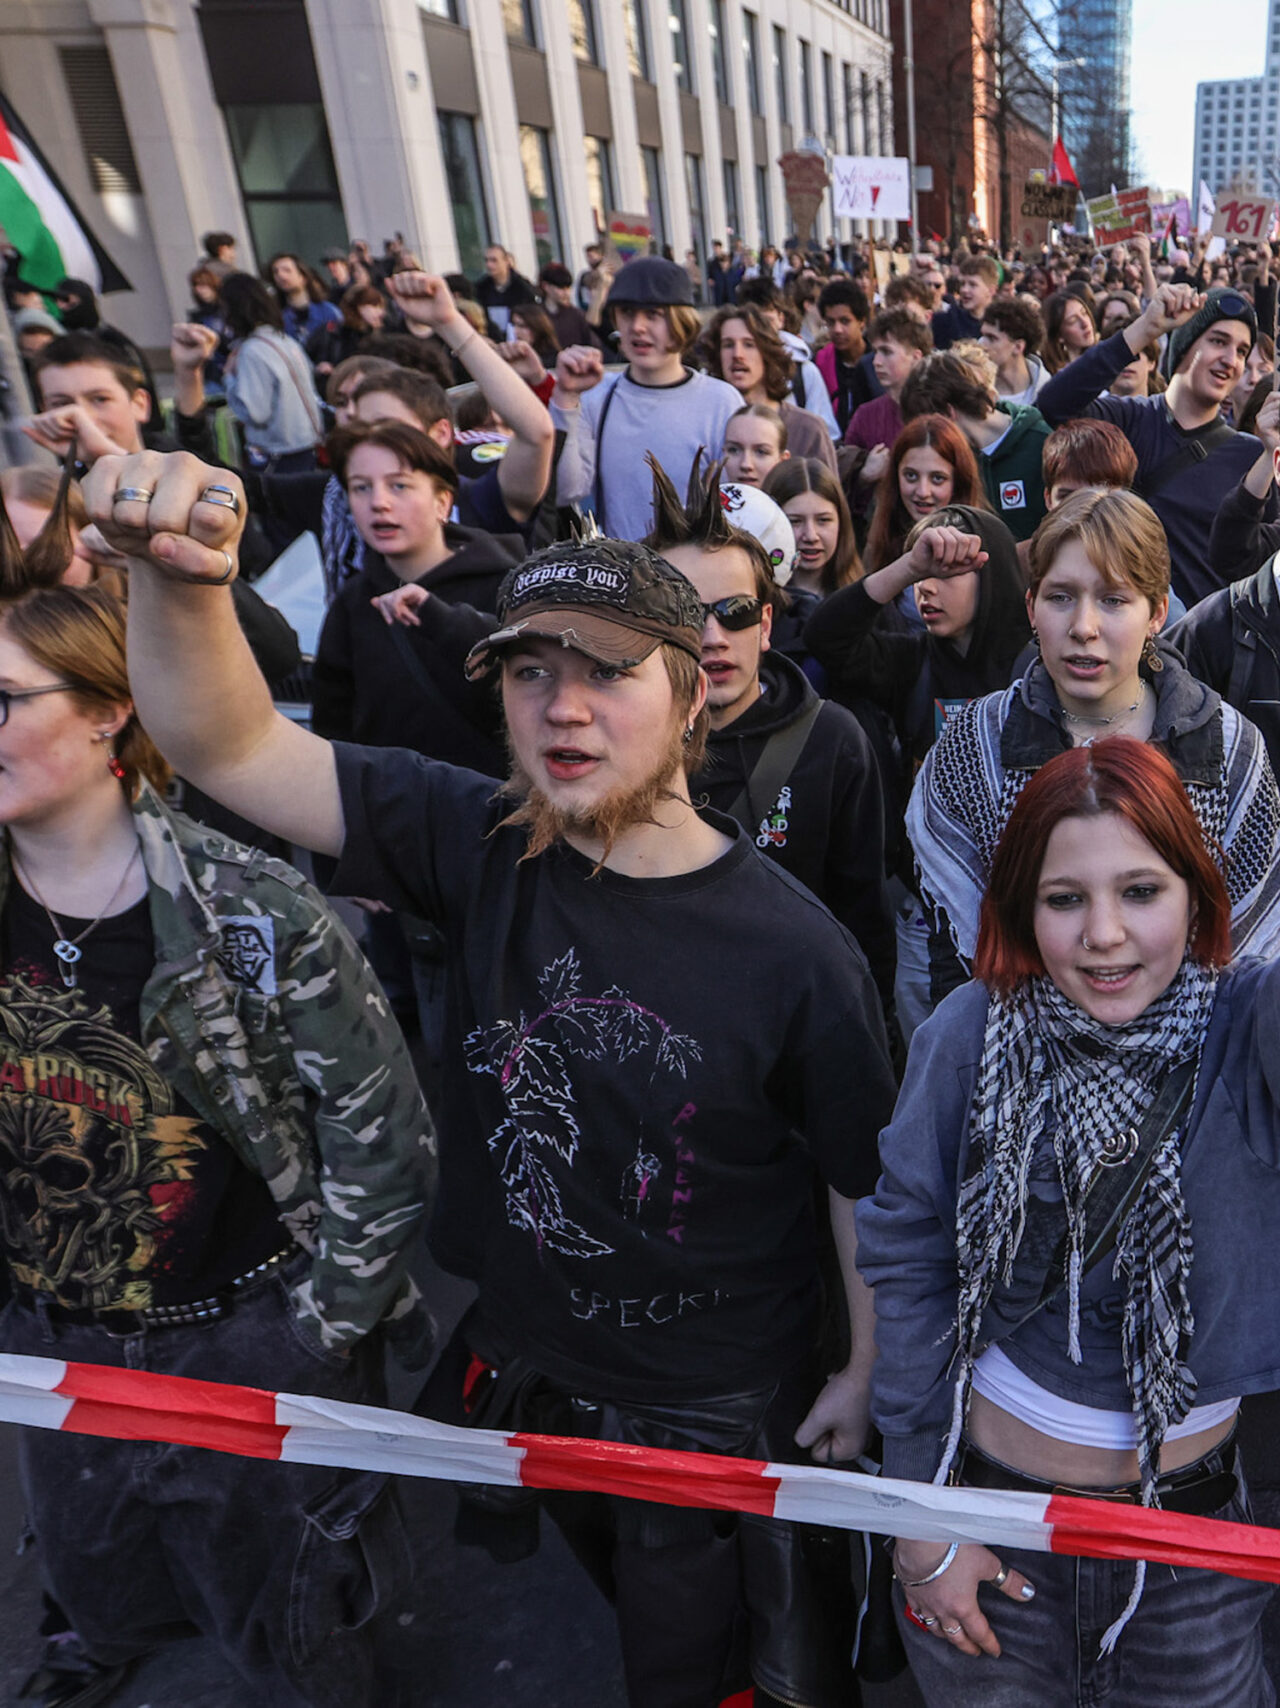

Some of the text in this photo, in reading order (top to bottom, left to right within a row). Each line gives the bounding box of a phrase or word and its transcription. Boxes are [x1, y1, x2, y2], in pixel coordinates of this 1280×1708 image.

[1219, 200, 1267, 238] 161
[586, 567, 619, 588] you
[36, 1054, 135, 1127] ROCK
